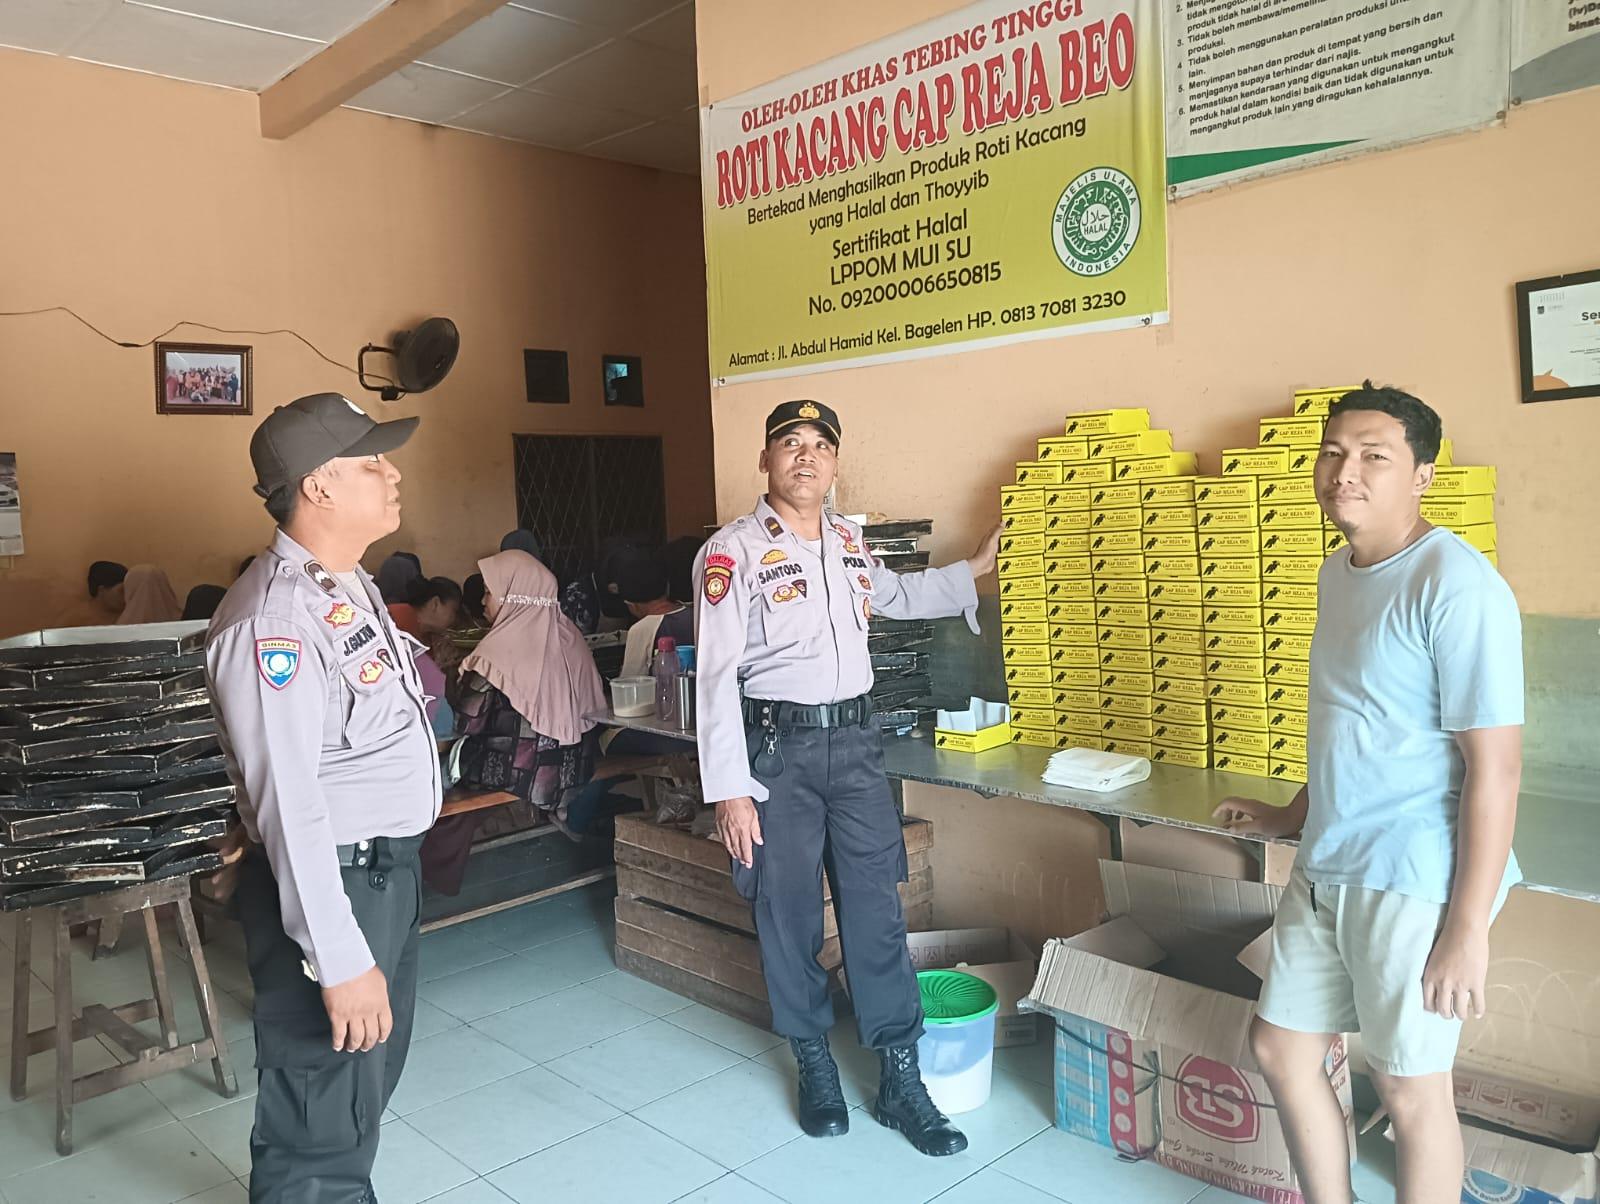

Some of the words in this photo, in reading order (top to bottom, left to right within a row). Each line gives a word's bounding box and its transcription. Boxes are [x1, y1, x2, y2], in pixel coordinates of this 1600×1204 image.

[1176, 4, 1183, 13] 2.
[1187, 8, 1207, 20] tidak
[1187, 17, 1216, 34] produk
[1217, 10, 1239, 23] tidak
[1240, 3, 1261, 15] halal
[1263, 0, 1272, 9] di
[1188, 54, 1211, 66] Tidak
[1212, 48, 1236, 60] boleh
[1237, 29, 1298, 52] menggunakan
[1299, 14, 1343, 35] peralatan
[1345, 0, 1388, 21] produksi
[1177, 39, 1184, 47] 3.
[1187, 31, 1210, 44] Tidak
[1212, 23, 1235, 36] boleh
[1178, 84, 1184, 93] 5.
[1188, 71, 1236, 90] Menyimpan
[1237, 63, 1264, 76] bahan
[1265, 57, 1282, 69] dan
[1284, 48, 1315, 64] produk
[1317, 45, 1326, 54] di
[1328, 34, 1362, 50] tempat
[1363, 27, 1387, 42] yang
[1389, 16, 1420, 32] bersih
[1423, 10, 1443, 22] dan
[1187, 38, 1226, 56] produksi.
[741, 78, 838, 133] OLEH-OLEH
[841, 57, 897, 98] KHAS
[903, 24, 987, 75] TEBING
[992, 0, 1084, 44] TINGGI
[1179, 107, 1185, 115] 6.
[1189, 94, 1238, 112] Memastikan
[1240, 80, 1286, 99] kendaraan
[1287, 75, 1309, 88] yang
[1310, 61, 1359, 80] digunakan
[1361, 51, 1389, 66] untuk
[1390, 33, 1455, 58] mengangkut
[1188, 68, 1206, 78] lain.
[1189, 82, 1239, 101] menjaganya
[1240, 73, 1271, 87] supaya
[1272, 60, 1314, 78] terhindar
[1316, 56, 1334, 66] dari
[1336, 48, 1361, 61] najis.
[1189, 111, 1218, 126] produk
[1220, 103, 1240, 116] halal
[1241, 97, 1269, 111] dalam
[1270, 88, 1301, 102] kondisi
[1303, 83, 1323, 94] baik
[1324, 77, 1342, 89] dan
[1344, 71, 1368, 84] tidak
[1370, 56, 1422, 77] digunakan
[1424, 47, 1454, 62] untuk
[716, 135, 771, 208] ROTI
[773, 96, 887, 189] KACANG
[893, 73, 955, 153] CAP
[961, 41, 1052, 134] REJA
[1058, 12, 1135, 104] BEO
[1190, 116, 1240, 136] mengangkut
[1242, 108, 1272, 124] produk
[1274, 104, 1290, 114] lain
[1292, 97, 1314, 112] yang
[1315, 86, 1362, 104] diragukan
[1364, 67, 1433, 91] kehalalannya.
[747, 193, 805, 225] Bertekad
[808, 169, 905, 208] Menghasilkan
[910, 148, 970, 179] Produk
[975, 135, 1010, 162] Roti
[1015, 117, 1086, 150] Kacang
[1055, 172, 1097, 223] MAJELIS
[1103, 171, 1137, 206] ULAMA
[809, 210, 843, 235] yang
[847, 196, 886, 223] Halal
[890, 189, 920, 211] dan
[925, 169, 989, 203] Thoyyib
[832, 222, 910, 259] Sertifikat
[916, 208, 968, 240] Halal
[1084, 223, 1108, 235] HALAL
[830, 254, 896, 286] LPPOM
[902, 243, 940, 271] MUI
[946, 236, 972, 259] SU
[1065, 242, 1131, 273] INDONESIA
[808, 295, 836, 315] No.
[841, 261, 1001, 309] 09200006650815
[728, 350, 769, 368] Alamat
[776, 344, 788, 362] Jl.
[790, 337, 827, 358] Abdul
[829, 331, 873, 351] Hamid
[876, 326, 901, 344] Kel.
[905, 317, 963, 342] Bagelen
[967, 309, 996, 330] HP.
[1000, 305, 1036, 325] 0813
[1040, 298, 1076, 319] 7081
[1082, 290, 1126, 312] 3230
[758, 562, 803, 584] SANTOSO
